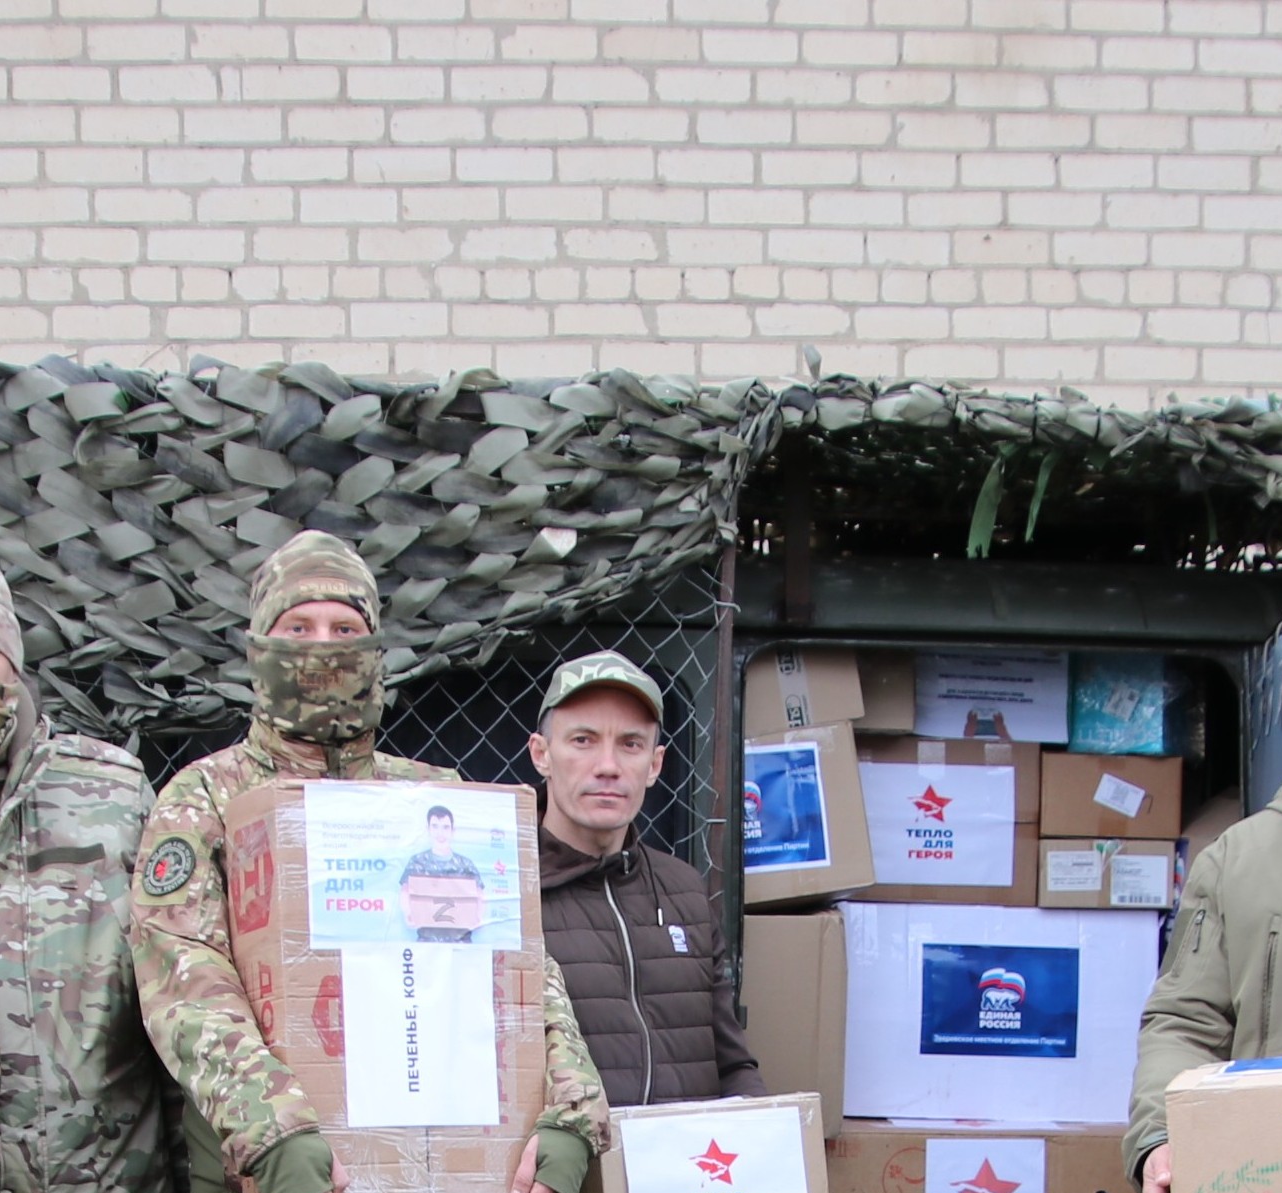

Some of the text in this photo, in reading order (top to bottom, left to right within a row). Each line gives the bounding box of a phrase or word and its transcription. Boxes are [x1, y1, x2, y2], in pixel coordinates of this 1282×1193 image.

[906, 829, 953, 838] ТЕПЛО
[923, 840, 953, 849] ДЛЯ
[908, 850, 953, 859] ГЕРОЯ
[324, 858, 387, 872] ТЕПЛО
[325, 878, 365, 893] ДЛЯ
[326, 899, 385, 911] ГЕРОЯ
[402, 948, 420, 1092] ПЕЧЕНЬЕ, КОНФ
[979, 1011, 1021, 1020] ЕДИНАЯ
[979, 1020, 1021, 1029] РОССИЯ
